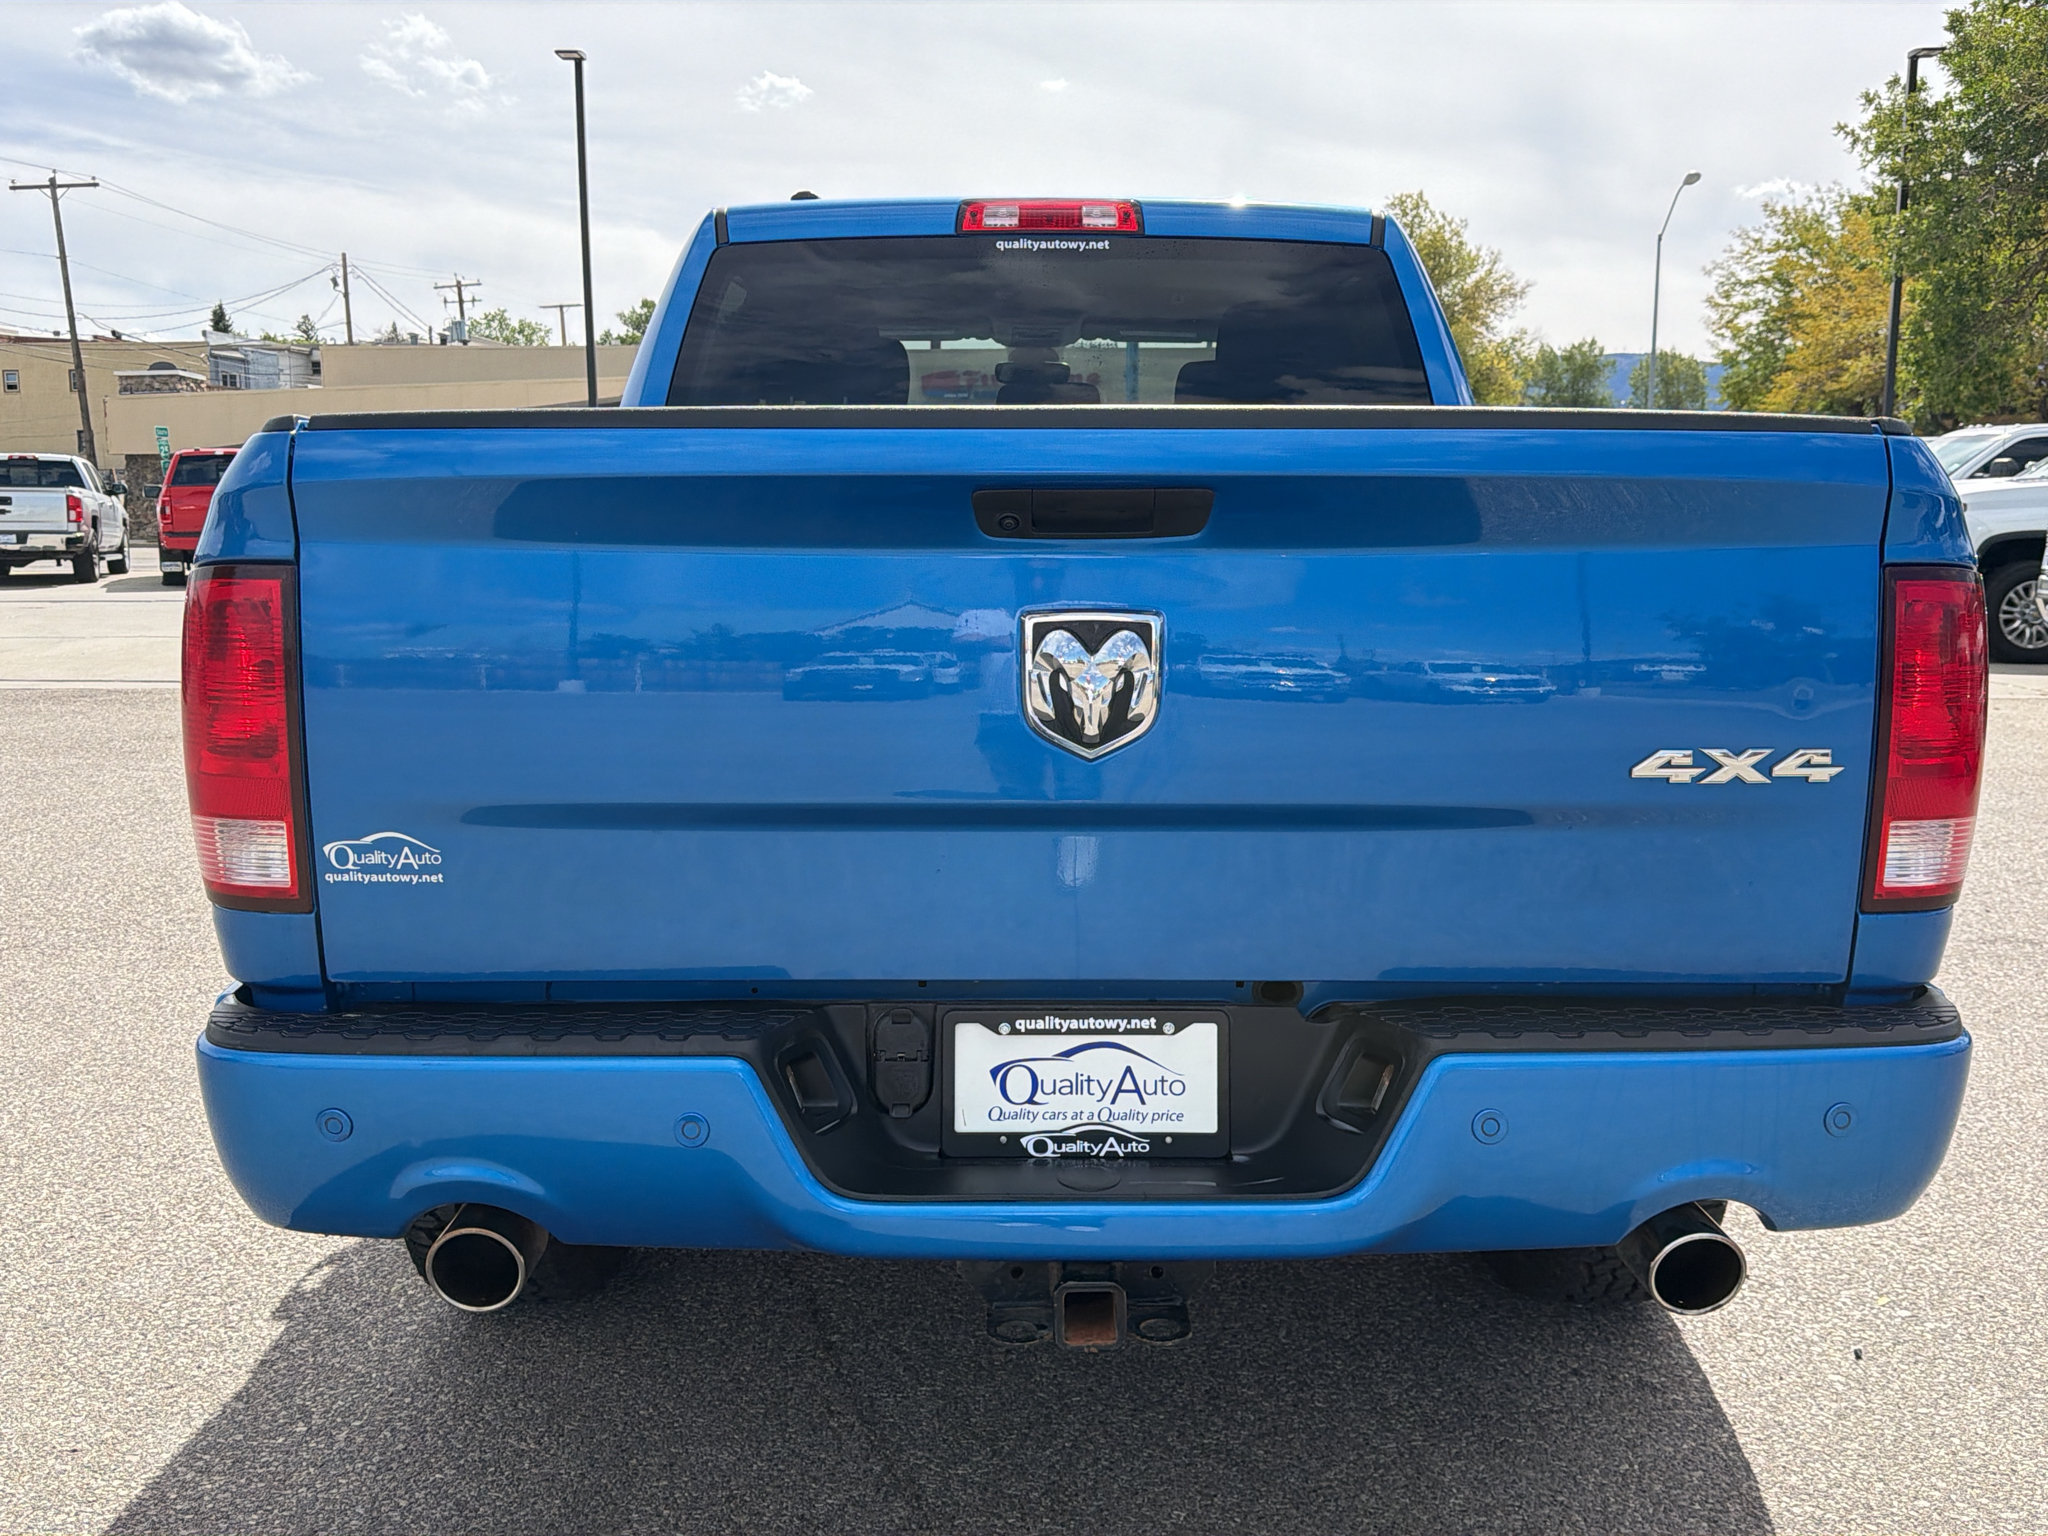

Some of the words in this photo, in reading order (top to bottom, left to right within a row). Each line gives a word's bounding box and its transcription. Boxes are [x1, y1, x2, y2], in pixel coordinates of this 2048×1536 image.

[996, 239, 1110, 251] qualityautowy.net
[1630, 748, 1845, 784] 4X4
[325, 871, 444, 885] qualityautowy.net
[1014, 1016, 1157, 1032] qualityautowy.net
[988, 1105, 1039, 1125] Quality
[1042, 1110, 1068, 1122] cars
[1071, 1109, 1086, 1122] at
[1087, 1111, 1095, 1122] a
[1097, 1106, 1149, 1125] Quality
[1151, 1109, 1184, 1125] price
